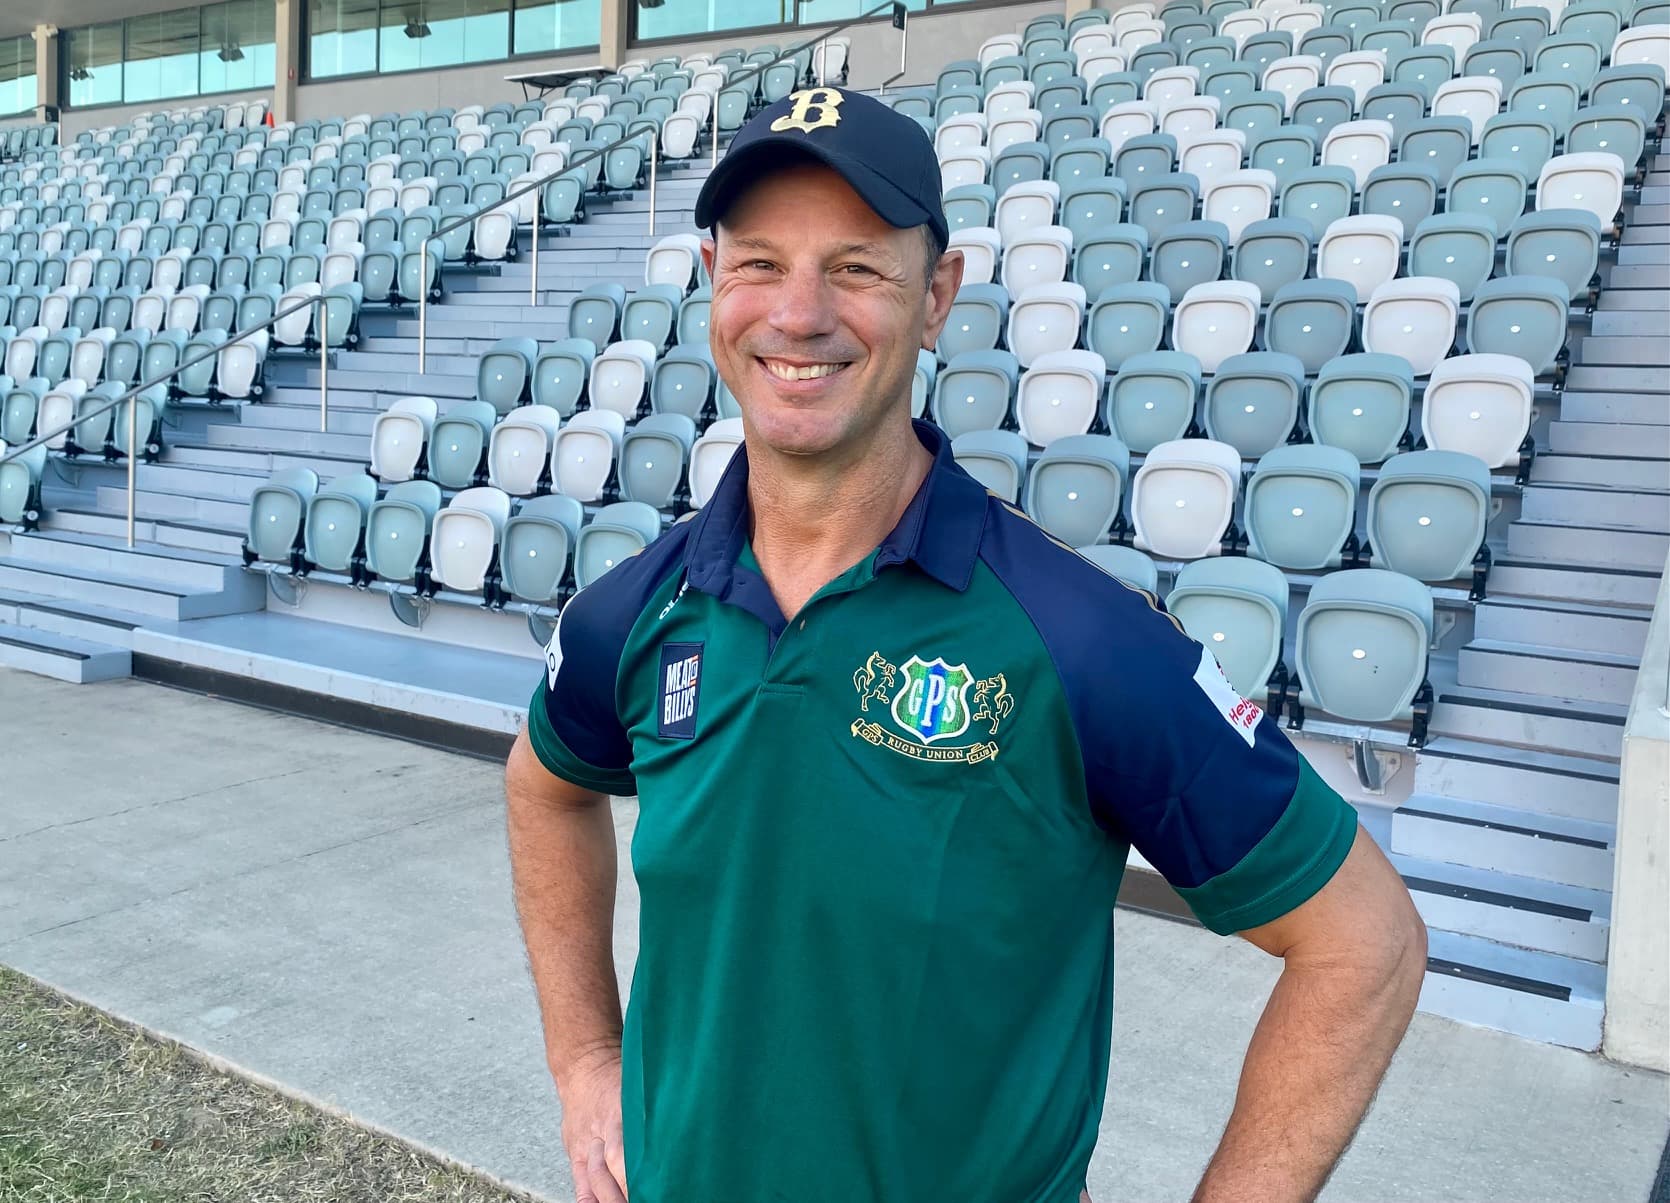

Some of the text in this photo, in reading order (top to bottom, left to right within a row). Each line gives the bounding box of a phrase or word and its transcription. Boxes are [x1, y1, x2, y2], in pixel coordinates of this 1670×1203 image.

[770, 87, 844, 134] B
[908, 674, 958, 727] GPS
[1228, 697, 1253, 725] Hel
[862, 728, 990, 761] GPS RUGBY UNION CLUB
